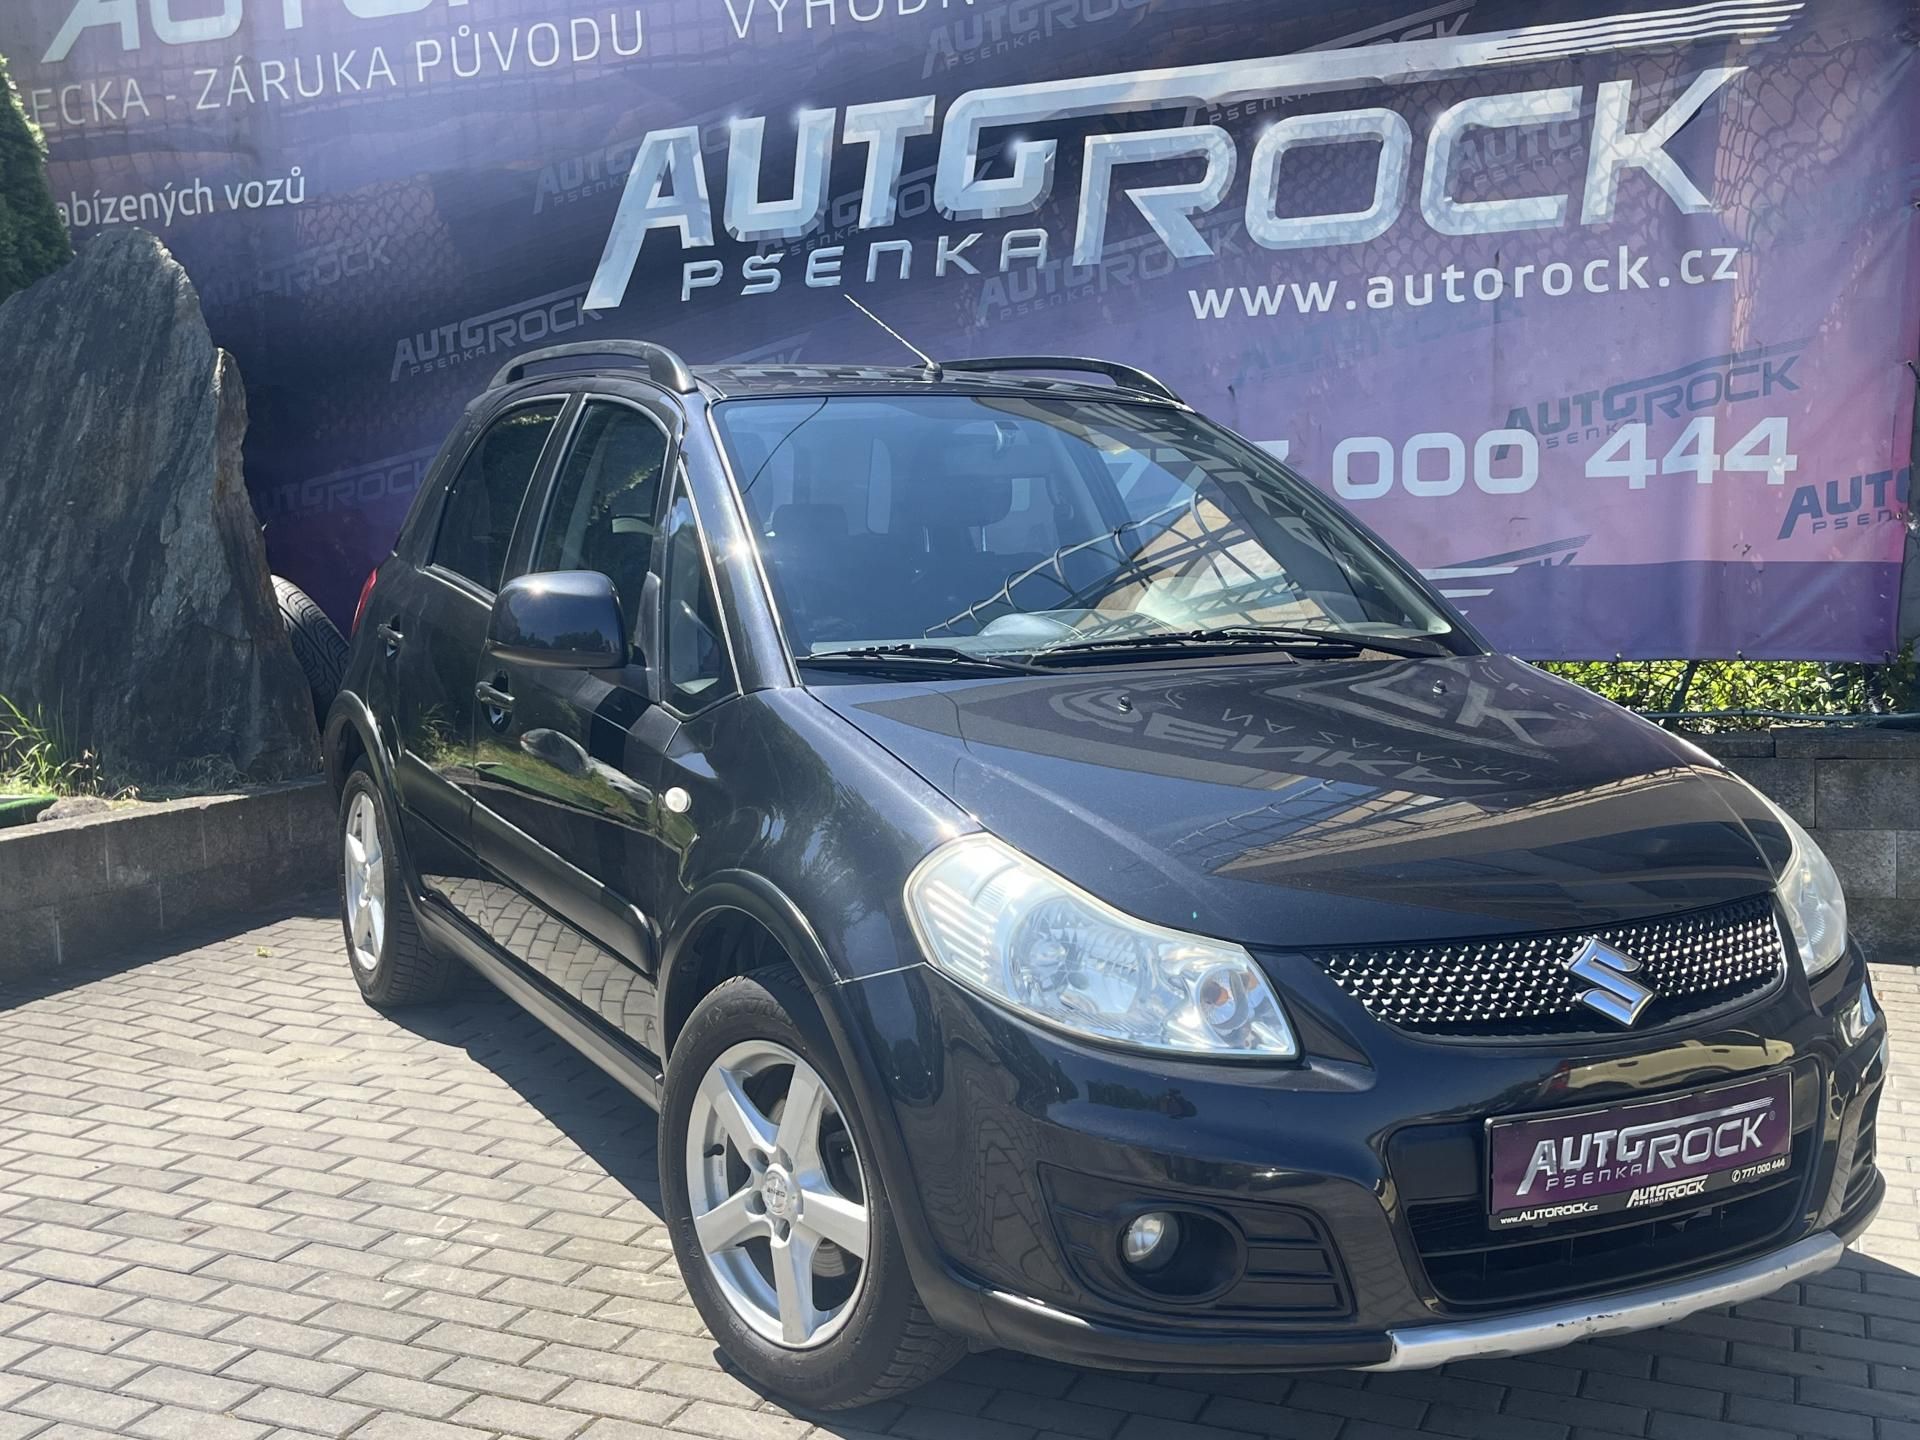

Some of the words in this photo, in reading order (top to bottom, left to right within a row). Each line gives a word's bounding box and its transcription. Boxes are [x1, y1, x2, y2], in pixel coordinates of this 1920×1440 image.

[193, 54, 397, 110] ZÁRUKA
[415, 10, 644, 82] PŮVODU
[224, 166, 305, 209] vozů
[1187, 245, 1739, 319] www.autorock.cz
[1331, 429, 1540, 501] 000
[1585, 416, 1798, 489] 444
